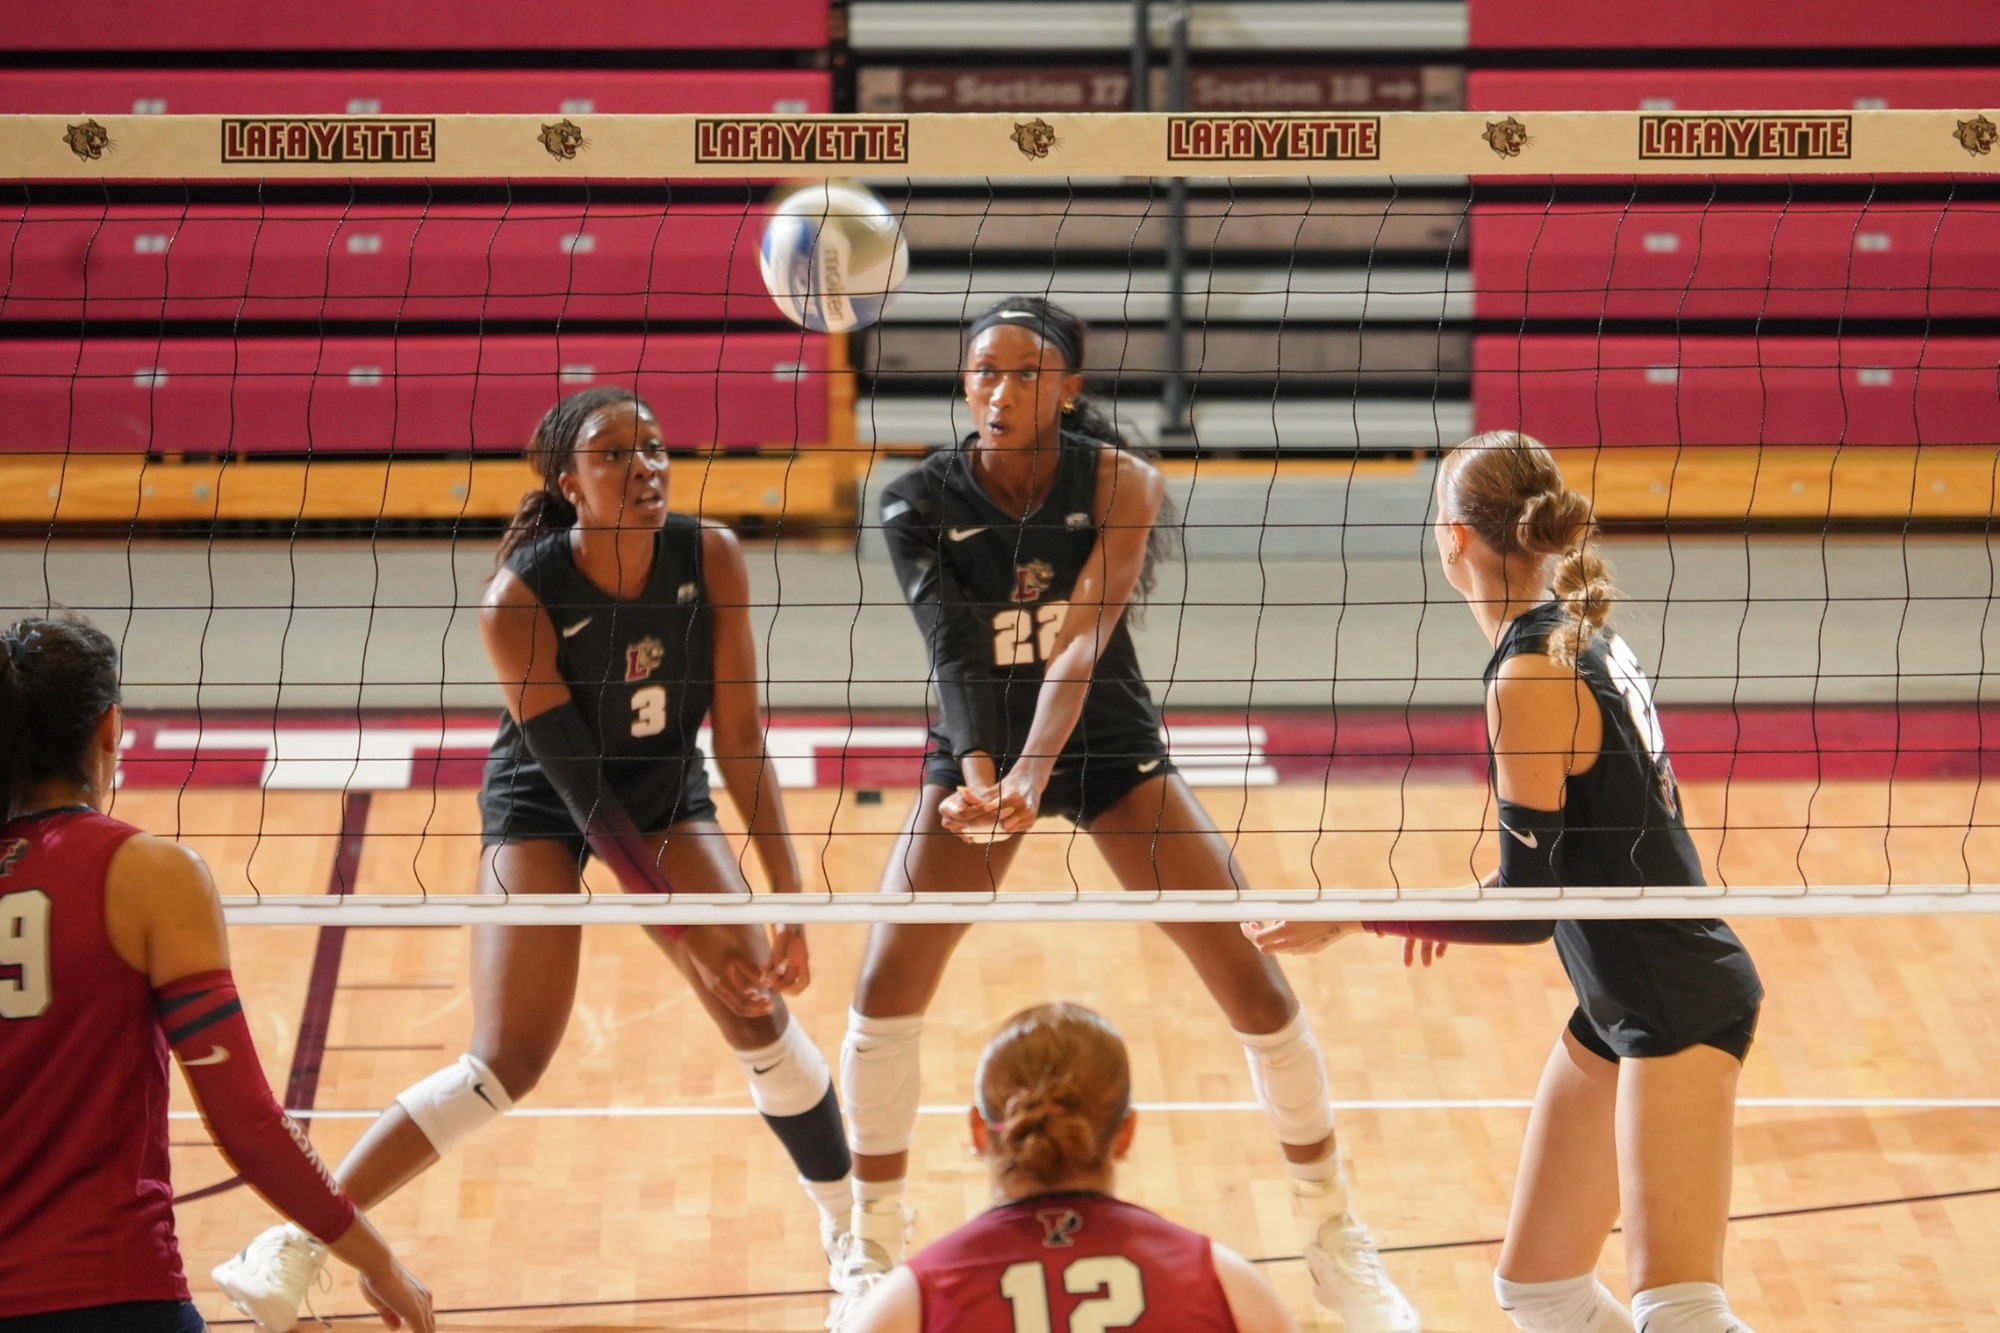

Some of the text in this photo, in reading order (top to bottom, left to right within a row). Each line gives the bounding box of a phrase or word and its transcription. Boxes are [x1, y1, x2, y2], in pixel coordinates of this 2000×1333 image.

[225, 121, 433, 161] LAFAYETTE
[699, 121, 906, 162] LAFAYETTE
[1171, 119, 1377, 158] LAFAYETTE
[1642, 118, 1849, 157] LAFAYETTE
[631, 685, 666, 738] 3
[0, 888, 52, 1019] 9
[1000, 1254, 1146, 1333] 12
